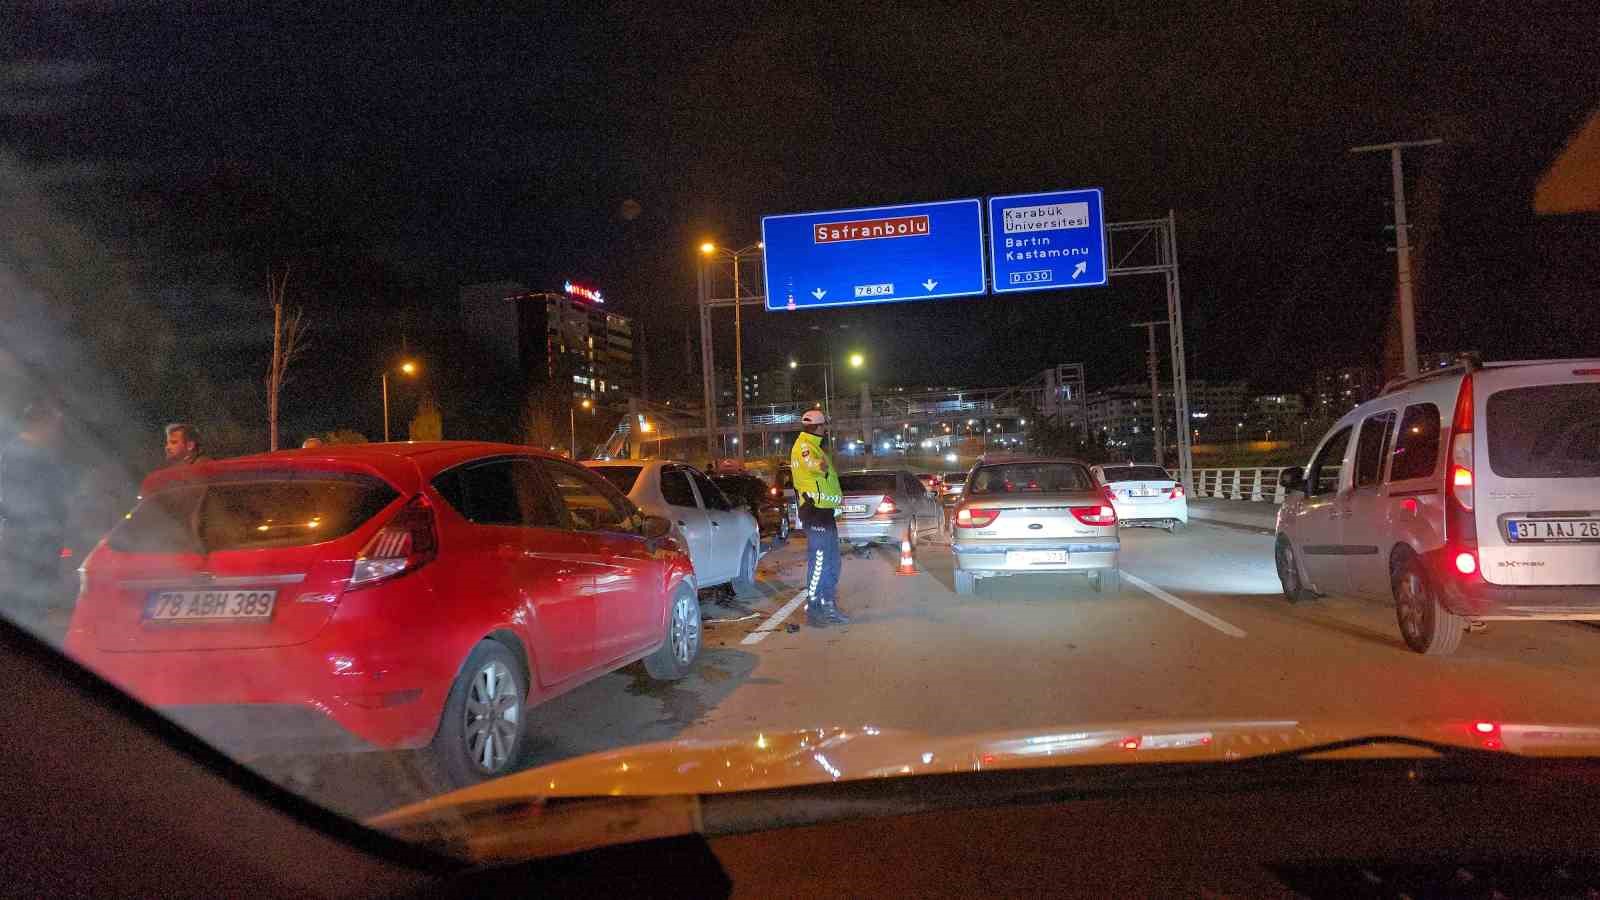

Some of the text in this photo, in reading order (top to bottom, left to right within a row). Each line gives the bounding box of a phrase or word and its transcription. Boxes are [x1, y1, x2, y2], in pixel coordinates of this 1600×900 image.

[1005, 207, 1064, 219] Karabük
[818, 219, 927, 240] Safranbolu
[1005, 217, 1088, 231] Üniversitesi
[1005, 237, 1050, 248] Bartın
[1006, 247, 1089, 261] Kastamonu
[1013, 272, 1048, 282] D.030
[1519, 523, 1537, 537] 37
[1547, 523, 1575, 537] AAJ
[156, 593, 184, 617] 78
[187, 593, 229, 616] ABH
[231, 592, 273, 615] 389
